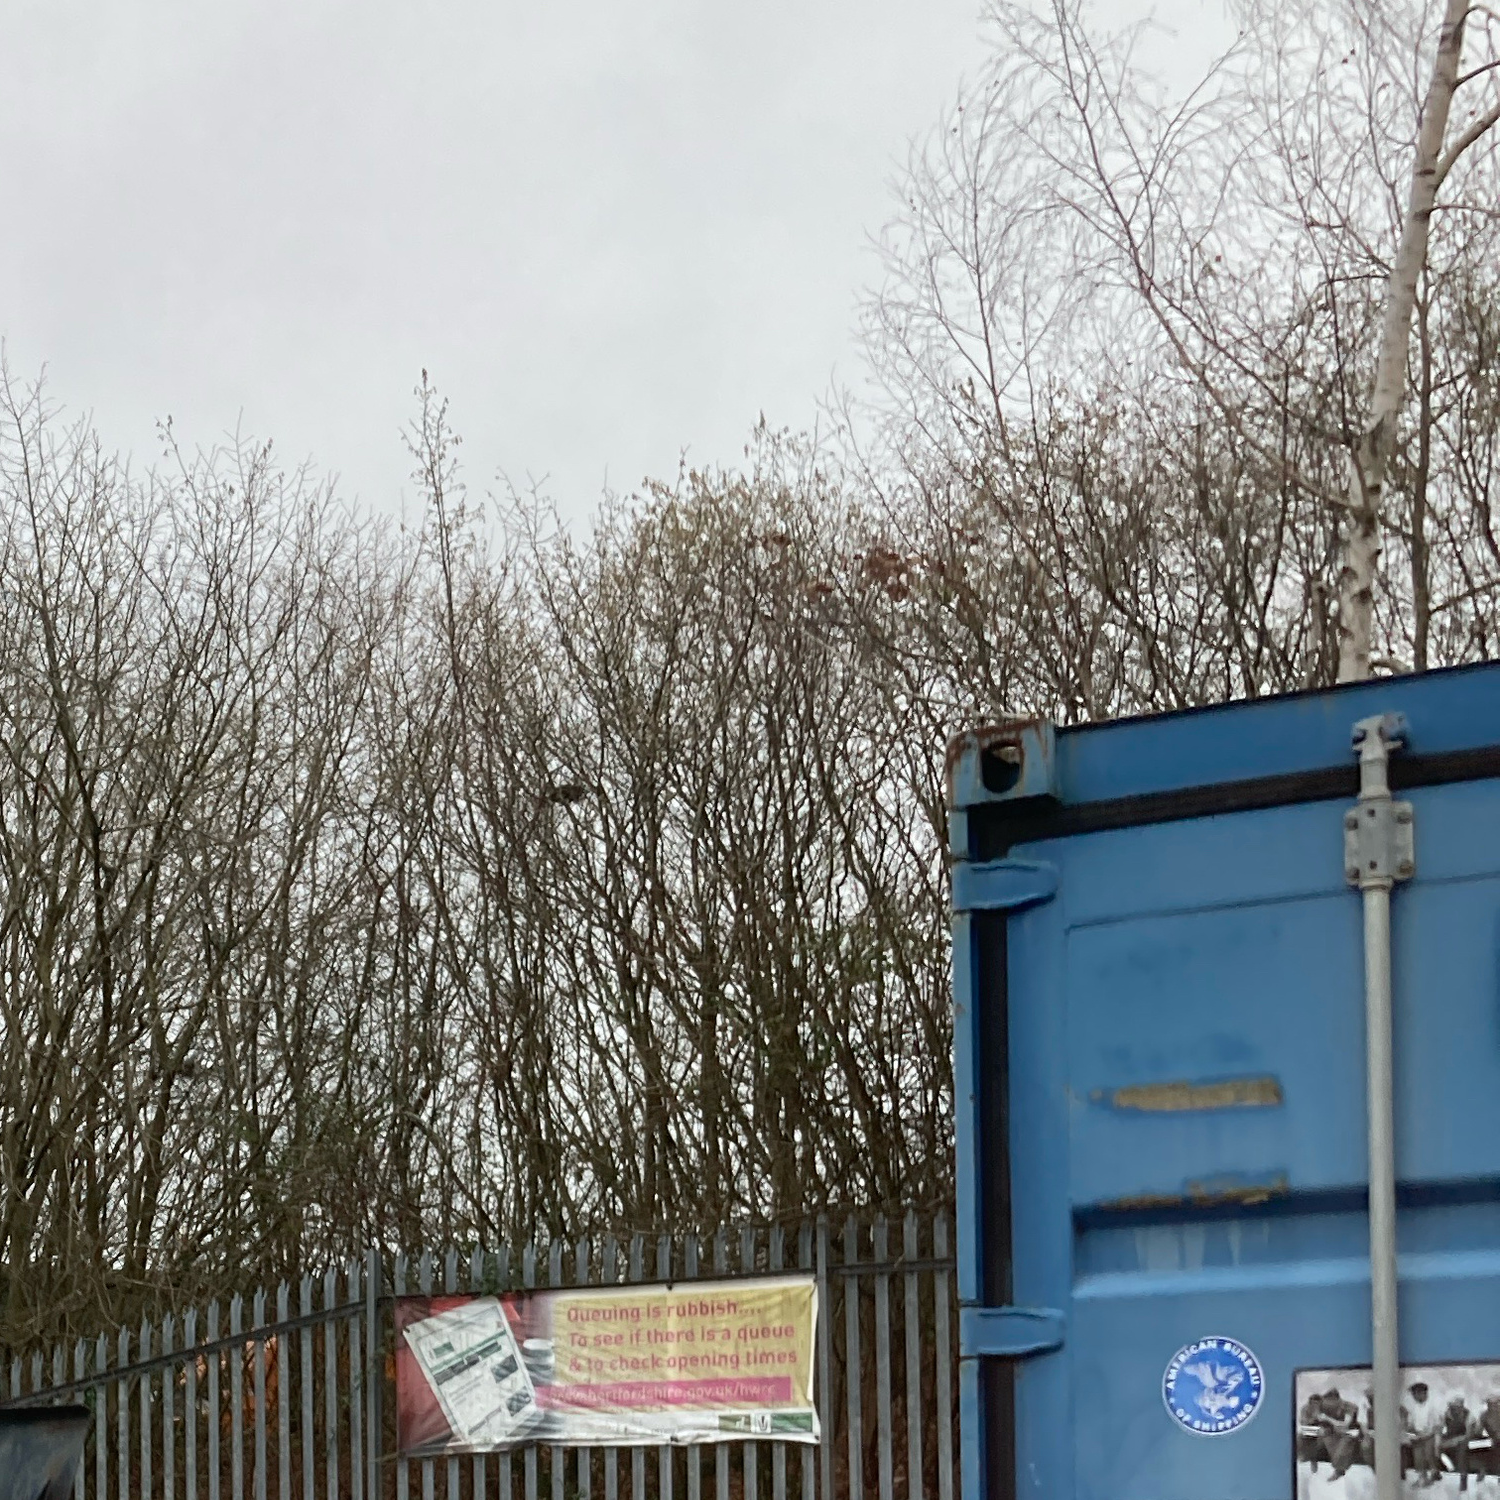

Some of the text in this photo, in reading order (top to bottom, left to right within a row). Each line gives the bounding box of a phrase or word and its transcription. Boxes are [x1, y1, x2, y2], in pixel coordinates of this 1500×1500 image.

[567, 1304, 641, 1323] Queuing
[646, 1301, 662, 1319] is
[570, 1324, 795, 1347] To see if there is a queue
[569, 1346, 797, 1372] & to check opening times
[1166, 1340, 1260, 1390] AMERICAN BUREAU
[1176, 1403, 1253, 1431] OF SHIPPING
